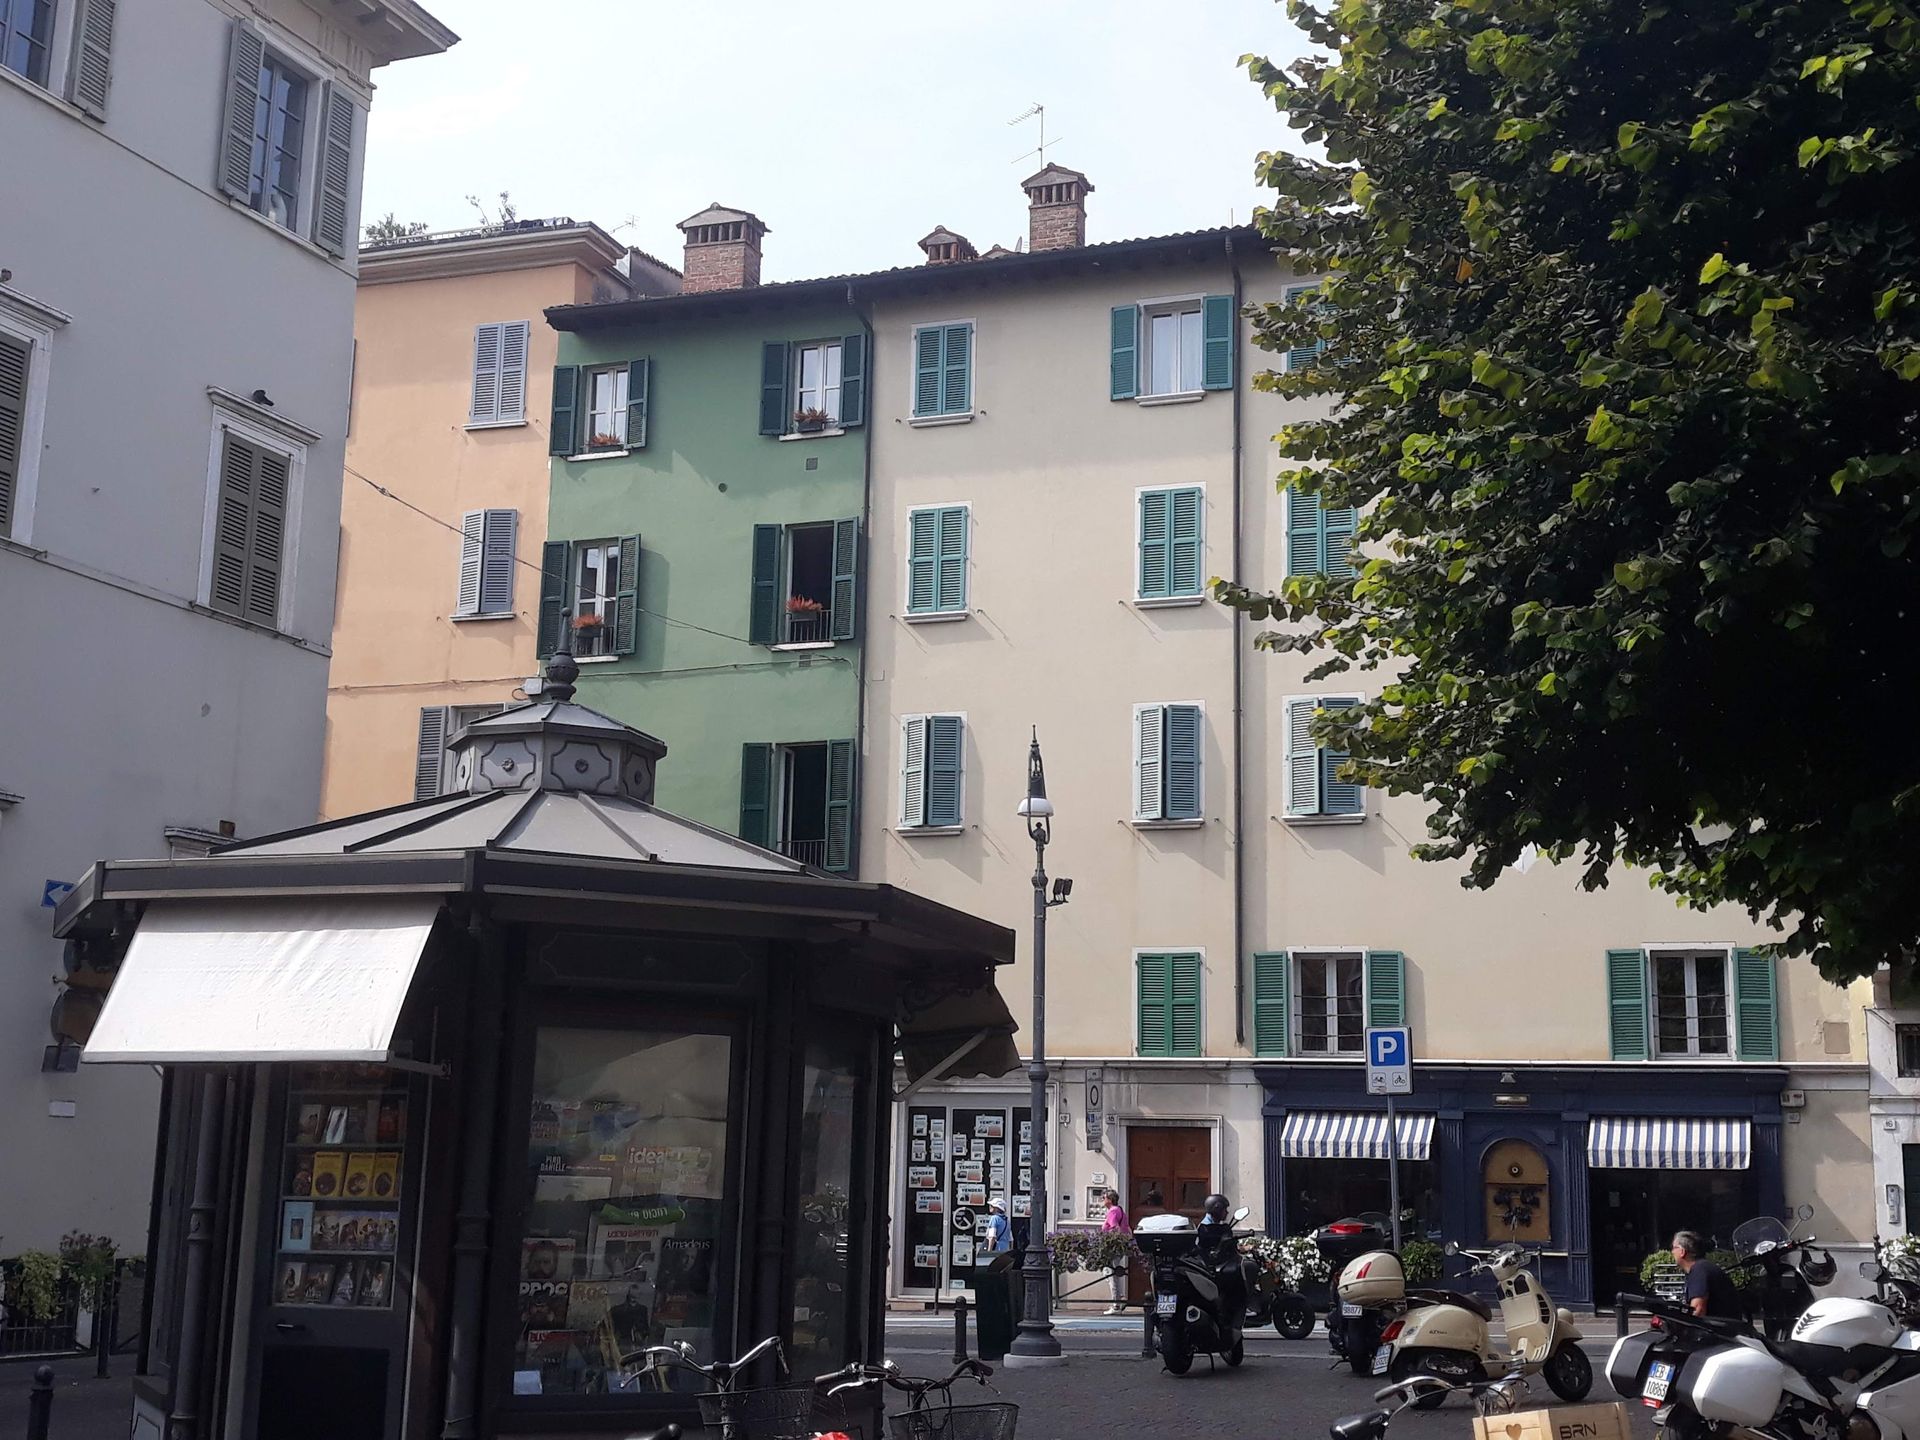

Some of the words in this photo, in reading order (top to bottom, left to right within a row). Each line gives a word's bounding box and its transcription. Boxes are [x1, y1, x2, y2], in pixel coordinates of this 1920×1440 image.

[1378, 1036, 1397, 1063] P
[664, 1239, 712, 1249] Amadeus
[1559, 1421, 1597, 1439] BRN
